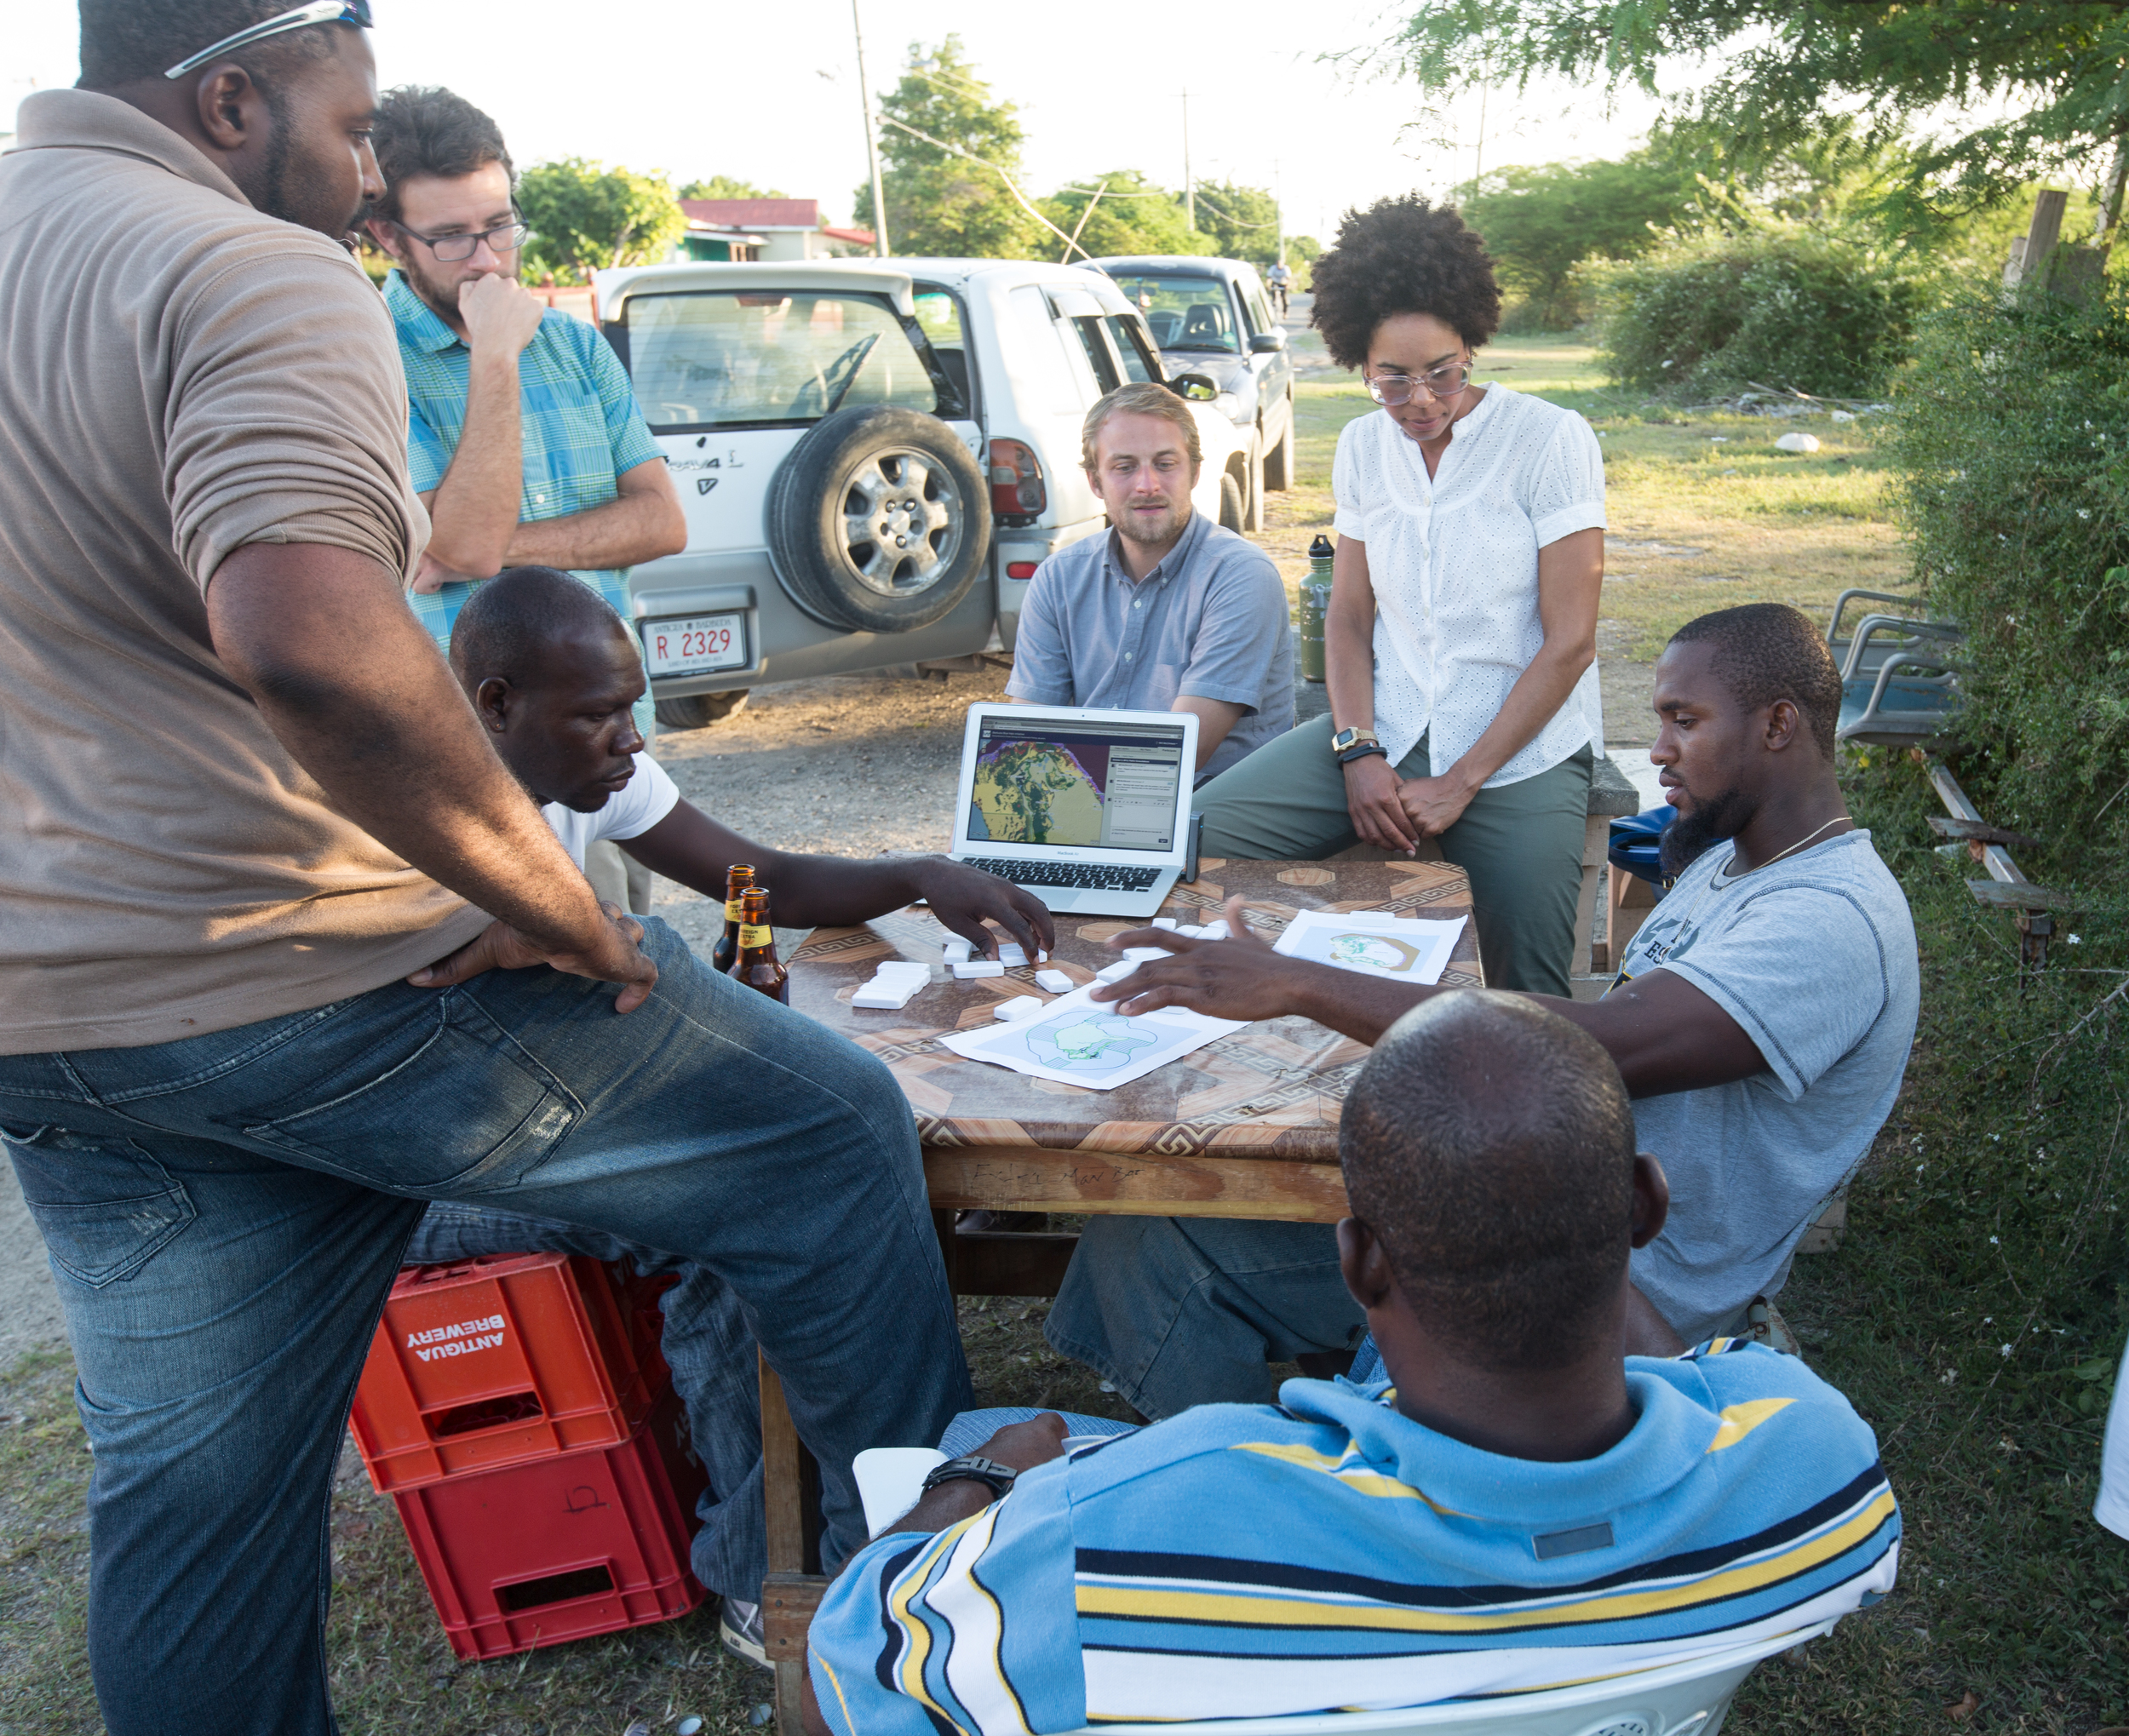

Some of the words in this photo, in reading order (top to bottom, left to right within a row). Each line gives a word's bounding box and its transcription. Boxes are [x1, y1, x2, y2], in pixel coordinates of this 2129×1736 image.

[657, 636, 669, 660] R
[681, 628, 731, 656] 2329
[407, 1314, 506, 1348] BREWERY
[416, 1332, 503, 1361] ANTIGUA
